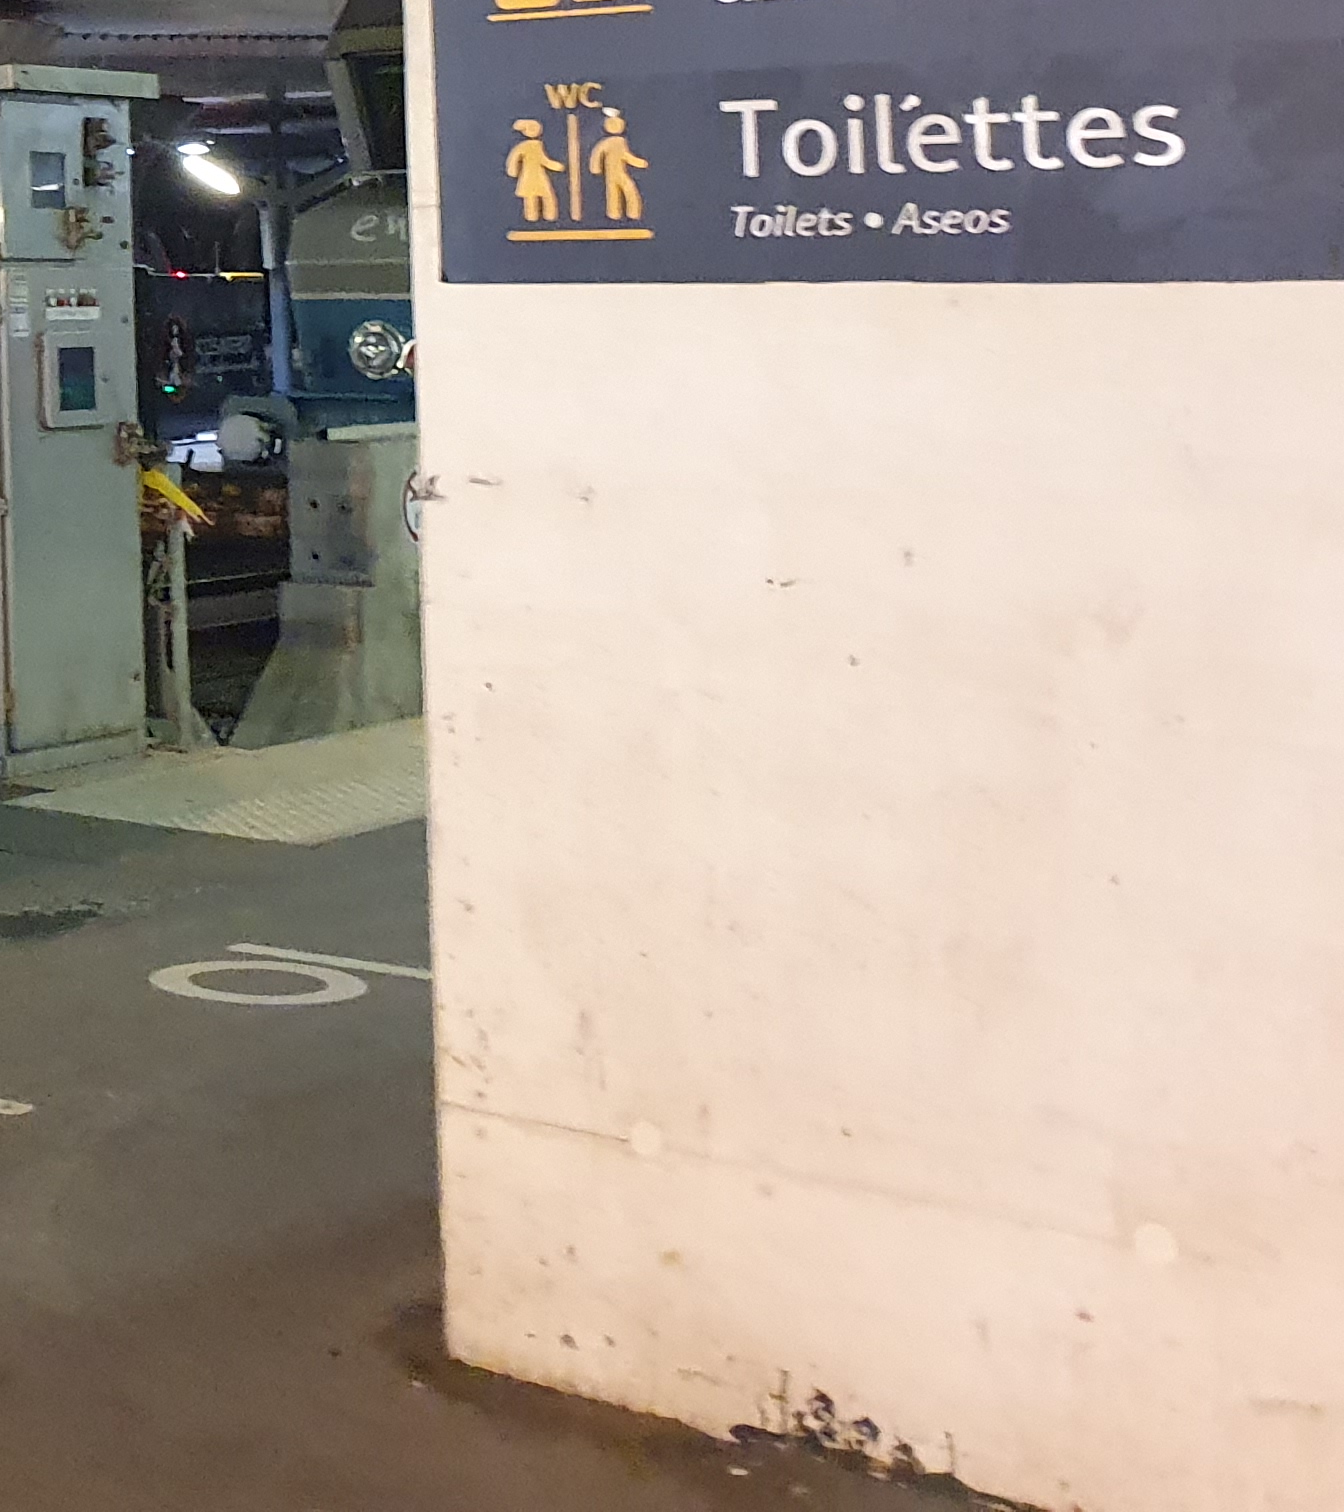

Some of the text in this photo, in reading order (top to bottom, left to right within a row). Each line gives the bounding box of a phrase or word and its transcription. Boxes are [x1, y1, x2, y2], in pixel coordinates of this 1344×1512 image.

[544, 81, 603, 109] WC
[730, 202, 1011, 238] Toilets Aseos
